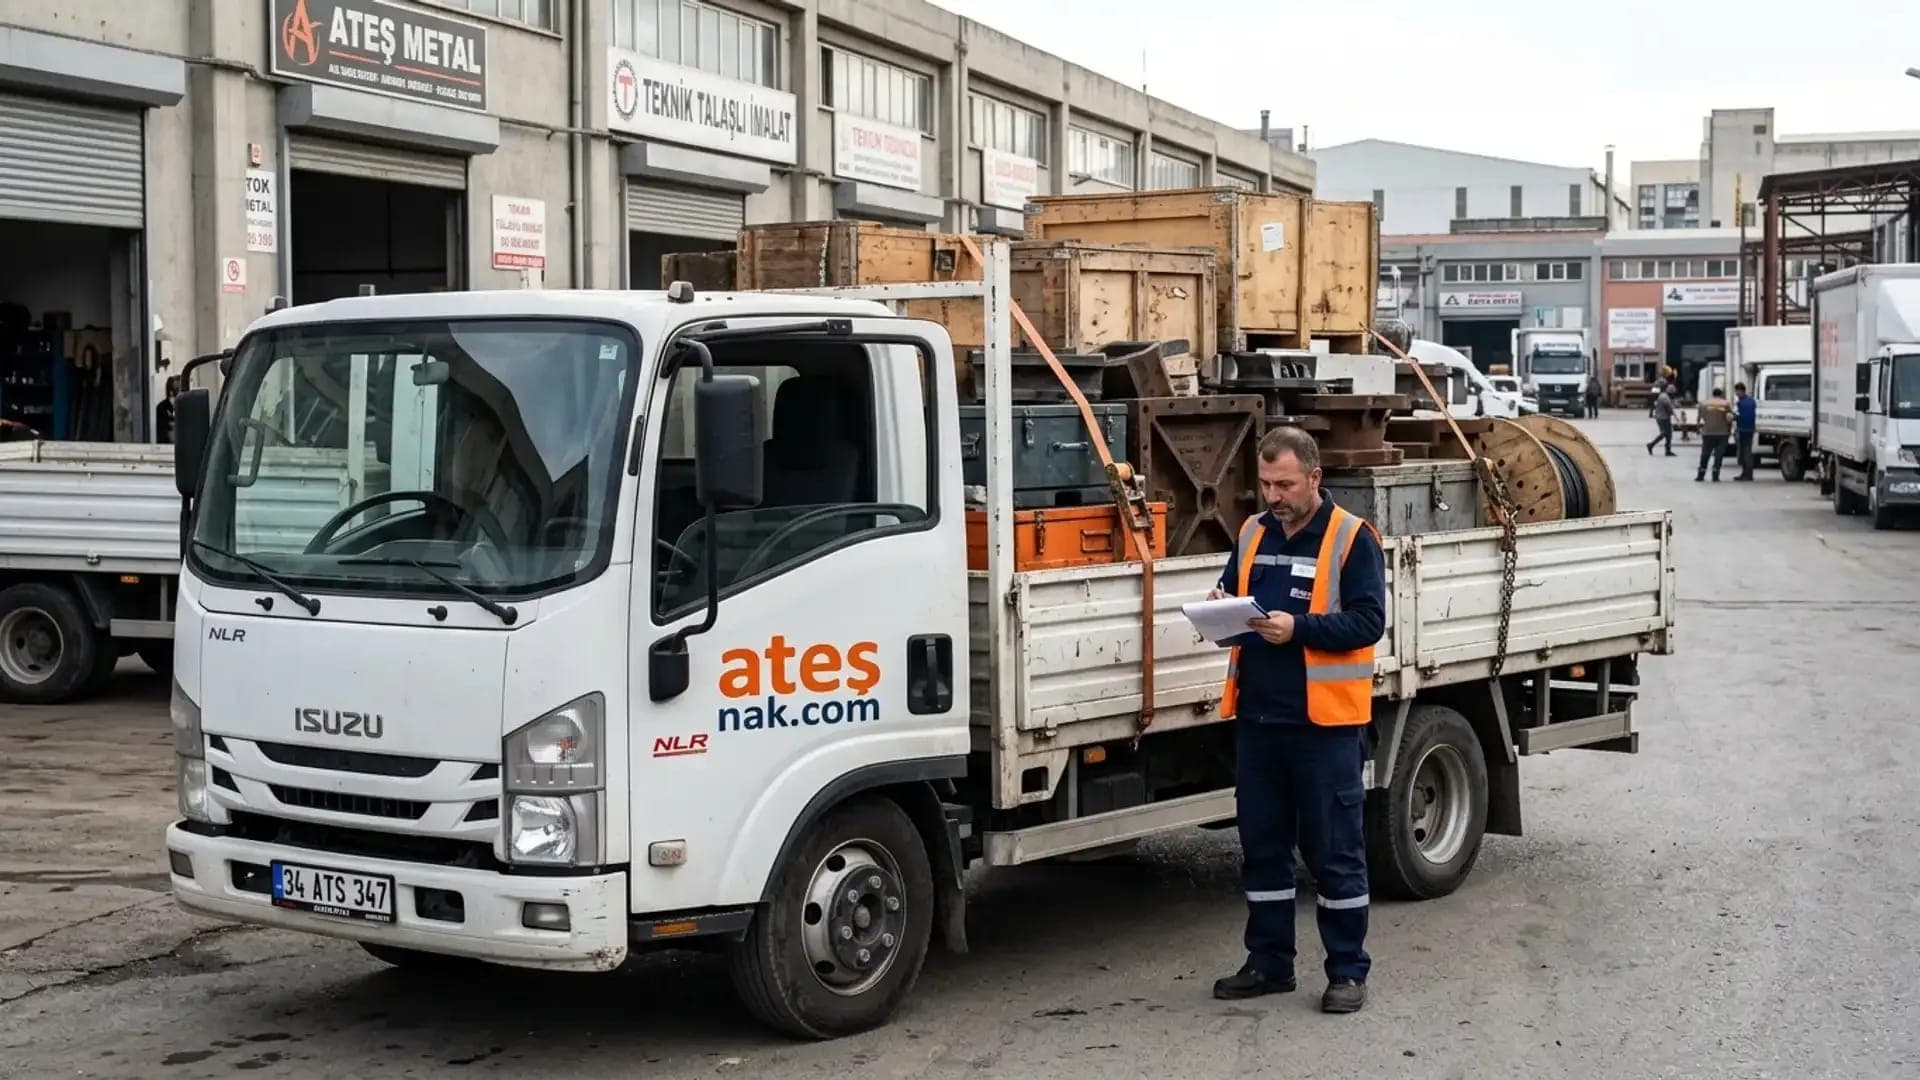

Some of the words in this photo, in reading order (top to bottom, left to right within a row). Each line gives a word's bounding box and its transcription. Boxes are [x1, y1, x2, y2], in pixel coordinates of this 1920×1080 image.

[328, 6, 396, 65] ATEŞ
[403, 23, 481, 75] METAL
[643, 78, 694, 123] TEKNİK
[697, 91, 746, 140] TALAŞLI
[750, 93, 791, 143] İMALAT
[208, 627, 246, 642] NLR
[719, 635, 881, 698] ateş
[295, 707, 383, 738] ISUZU
[718, 695, 880, 732] nak.com
[653, 734, 708, 752] NLR
[284, 869, 305, 899] 34
[313, 872, 346, 903] ATS
[353, 878, 387, 910] 347
